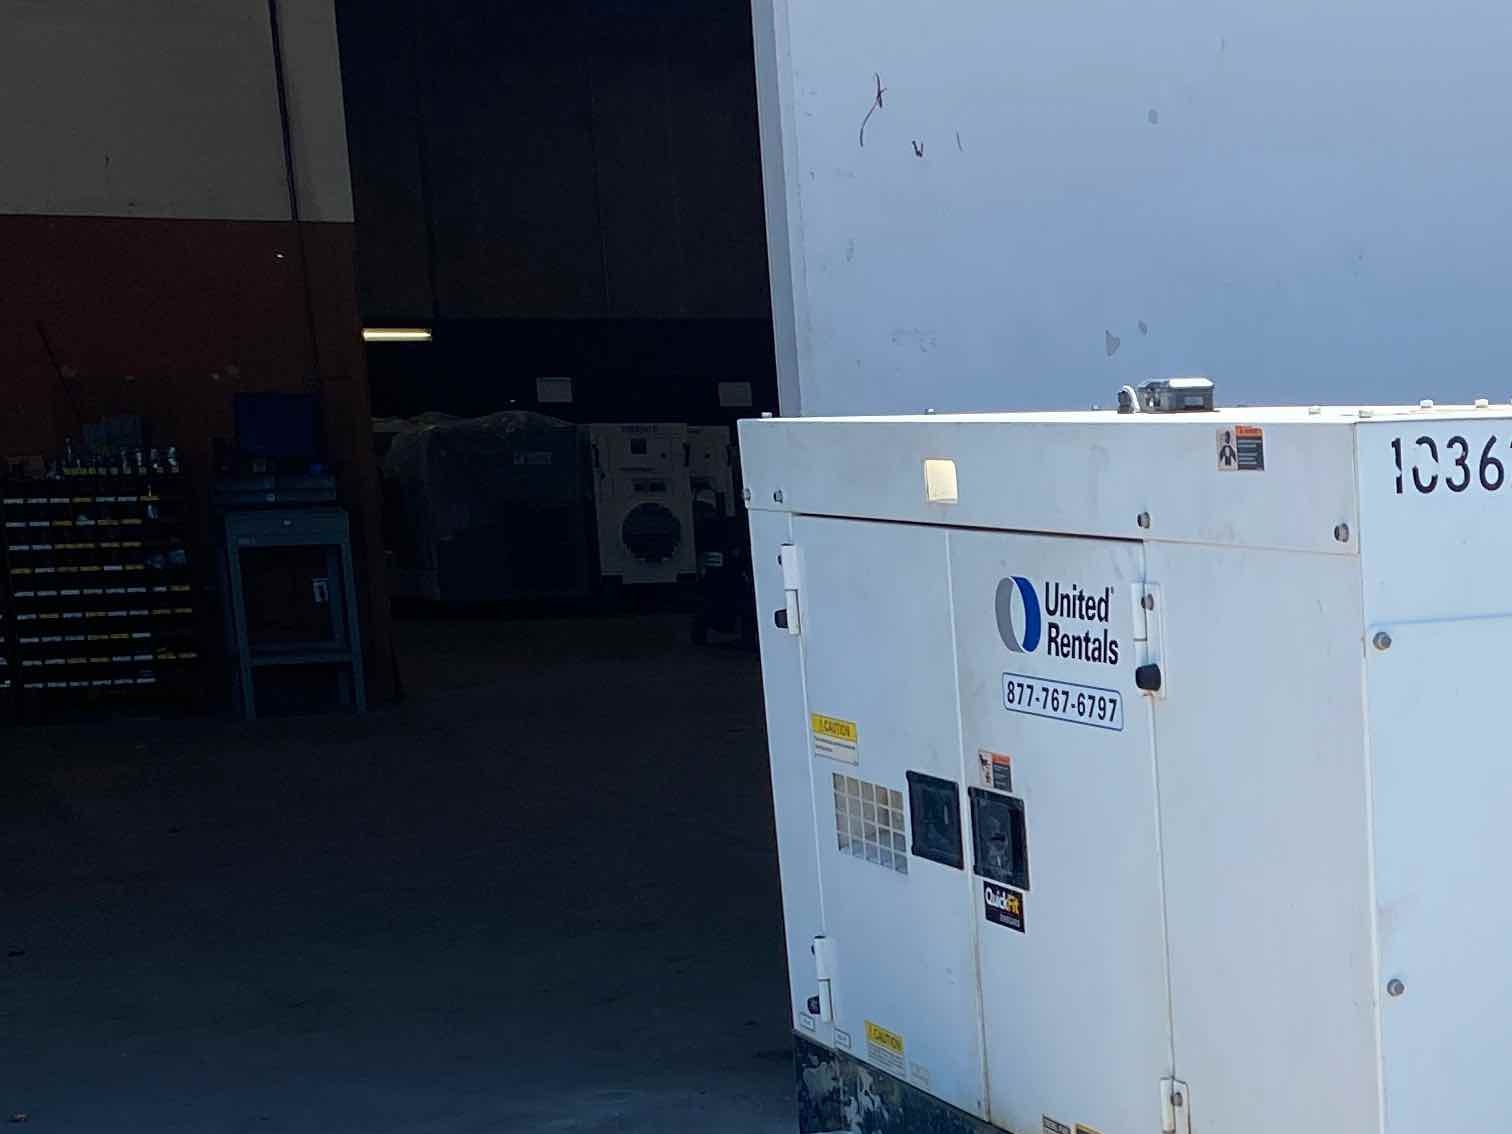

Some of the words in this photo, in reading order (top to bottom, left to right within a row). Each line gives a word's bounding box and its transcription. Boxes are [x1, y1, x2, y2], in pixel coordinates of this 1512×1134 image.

[1045, 581, 1110, 623] United
[1047, 622, 1119, 665] Rentals
[1007, 680, 1118, 722] 877-767-6797
